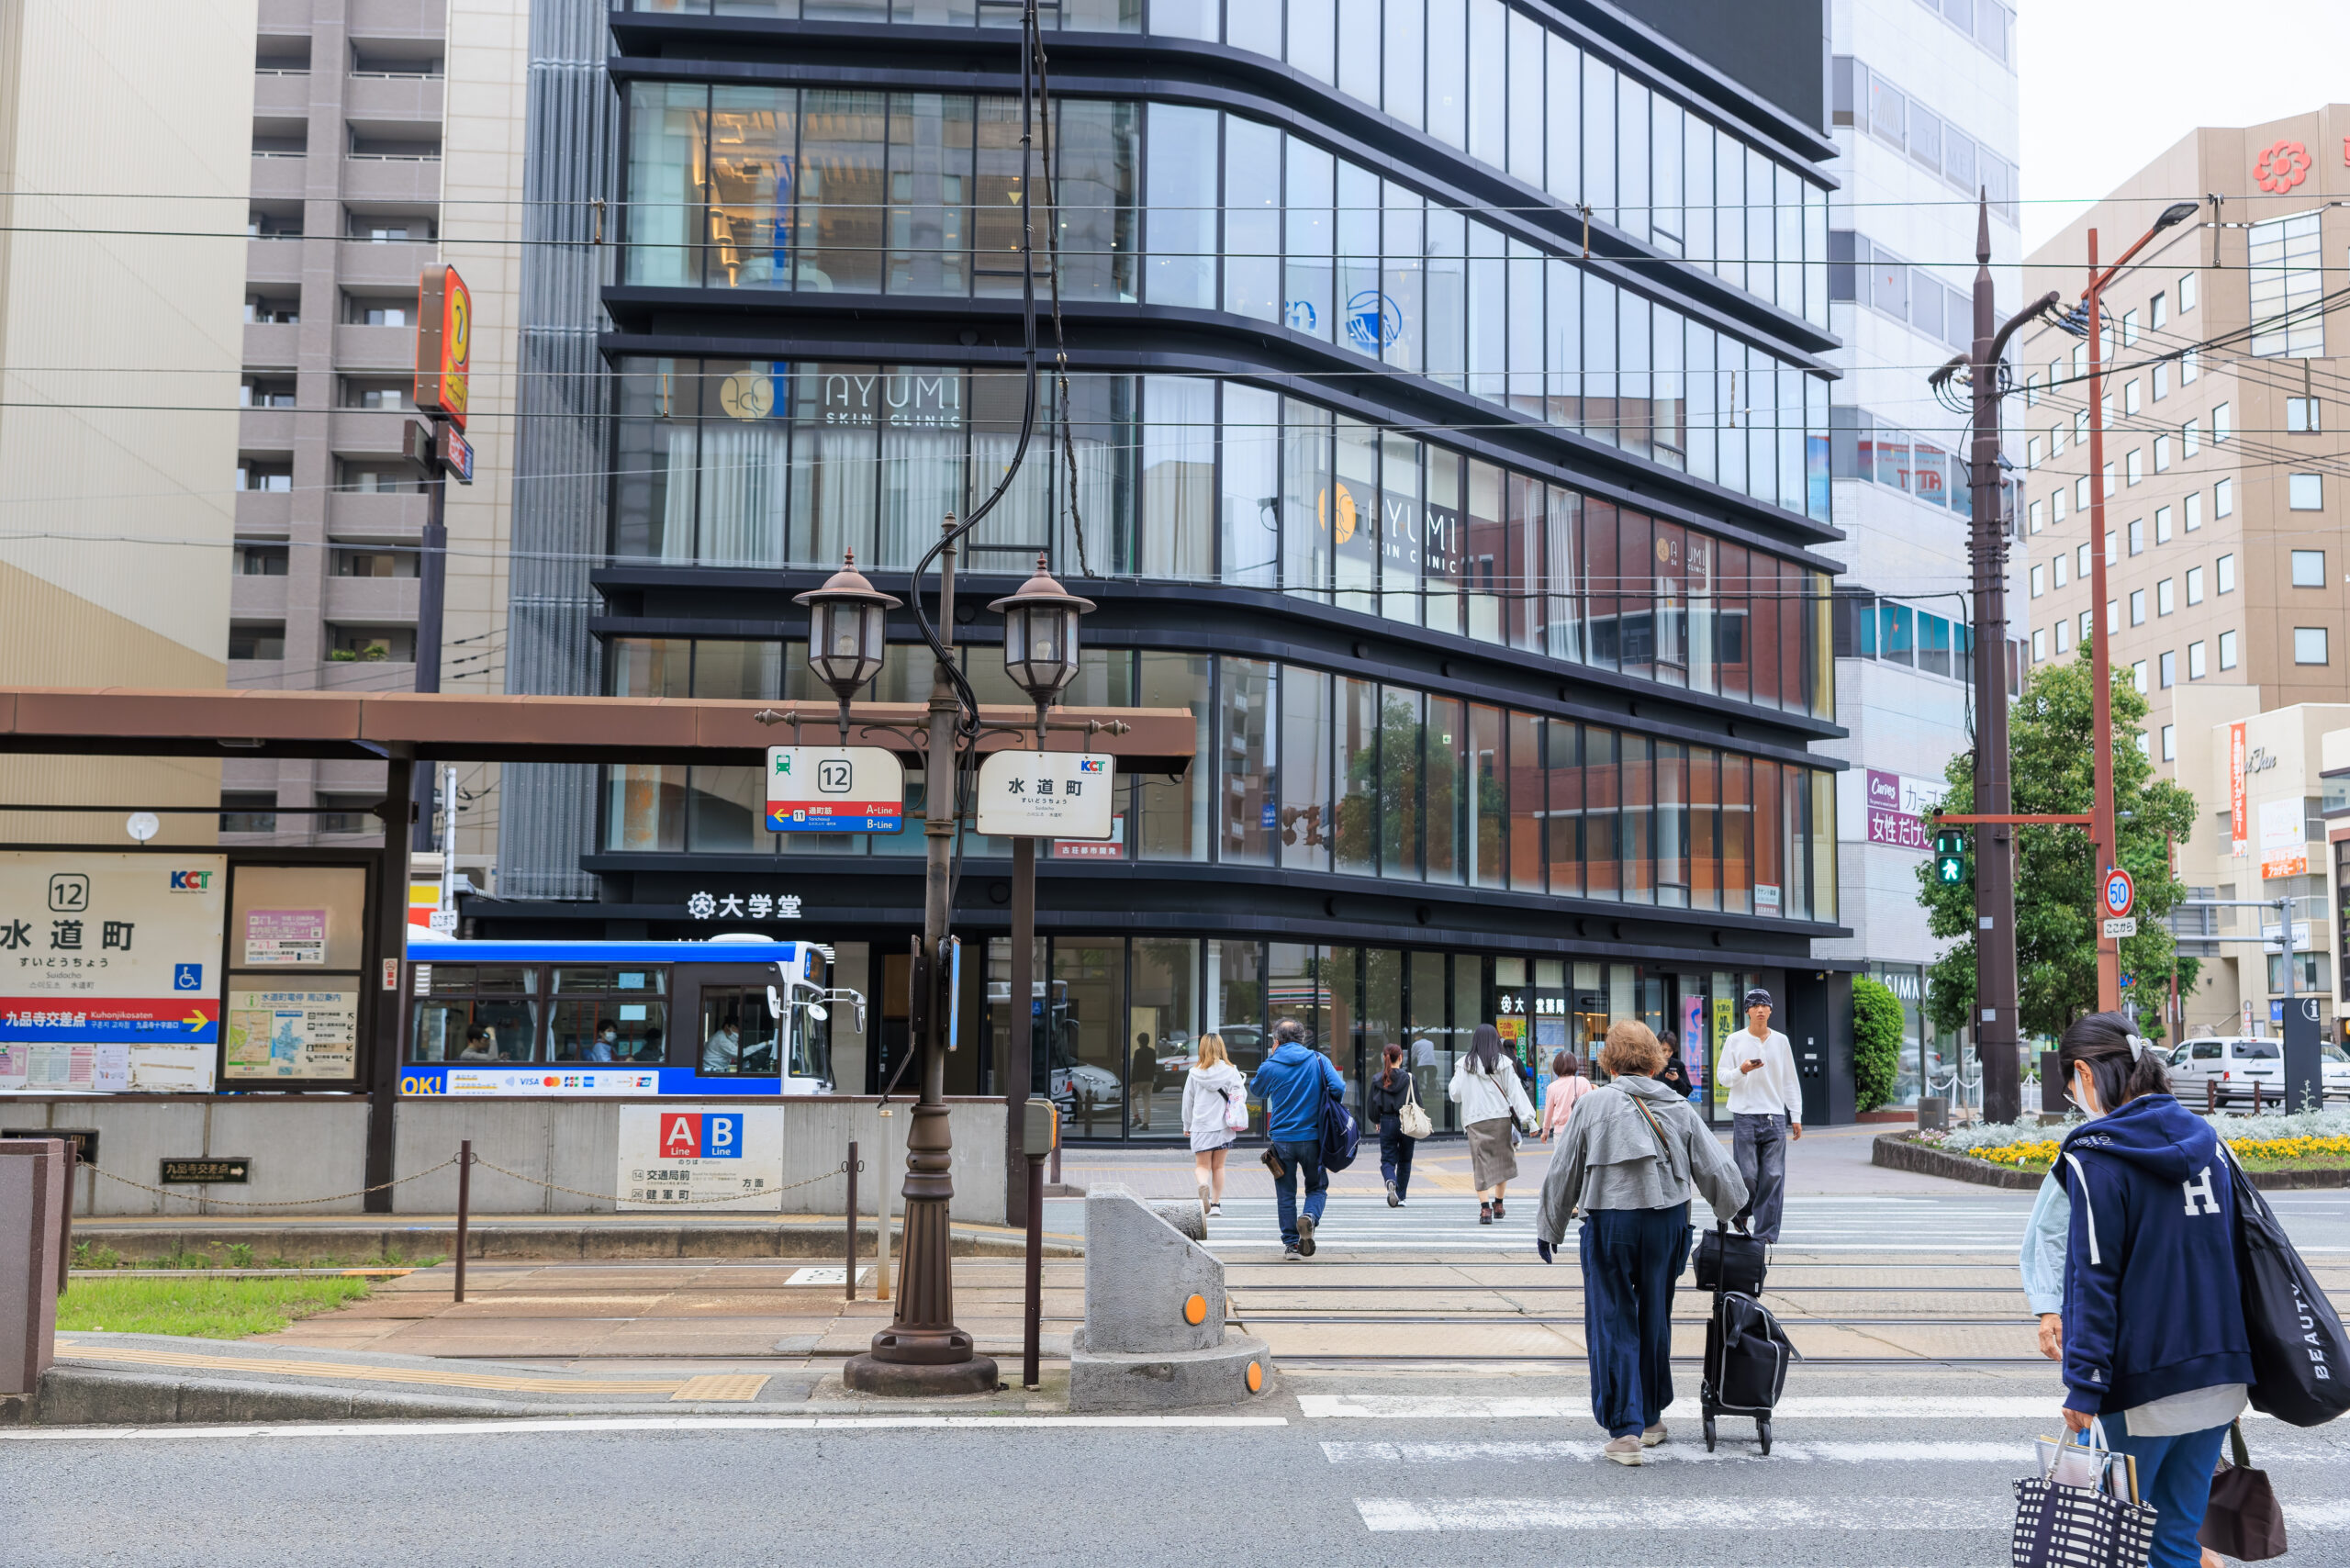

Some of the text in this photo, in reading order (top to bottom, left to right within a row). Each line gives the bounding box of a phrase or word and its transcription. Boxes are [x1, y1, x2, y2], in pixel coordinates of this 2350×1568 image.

[826, 375, 960, 410] AYUMI
[826, 412, 960, 428] SKIN CLINIC
[1409, 549, 1456, 574] CINIC
[1080, 760, 1105, 771] KCT
[822, 767, 848, 786] 12
[1008, 778, 1082, 796] 水道町
[1871, 778, 1896, 800] Curves
[794, 807, 833, 820] 11 通町筋
[866, 804, 893, 815] A-Line
[867, 819, 893, 830] B-Line
[170, 870, 213, 889] KCT
[53, 883, 83, 905] 12
[2109, 882, 2127, 904] 50
[719, 892, 802, 919] 大学堂
[0, 918, 135, 951] 水道町
[2106, 922, 2133, 934] ここから
[19, 958, 109, 969] すいどうちょう
[46, 970, 82, 980] Suidocho
[1516, 997, 1565, 1014] 大堂薬局
[6, 1012, 86, 1028] 九品寺交差点
[91, 1012, 153, 1021] Kuhonjikosaten
[400, 1076, 442, 1094] OK!
[520, 1077, 540, 1086] VISA
[666, 1117, 733, 1147] A B
[670, 1147, 732, 1156] Line Line
[646, 1170, 690, 1181] 交通局前
[742, 1179, 764, 1188] 方面
[632, 1190, 689, 1200] 26 健軍町
[2183, 1166, 2221, 1216] H
